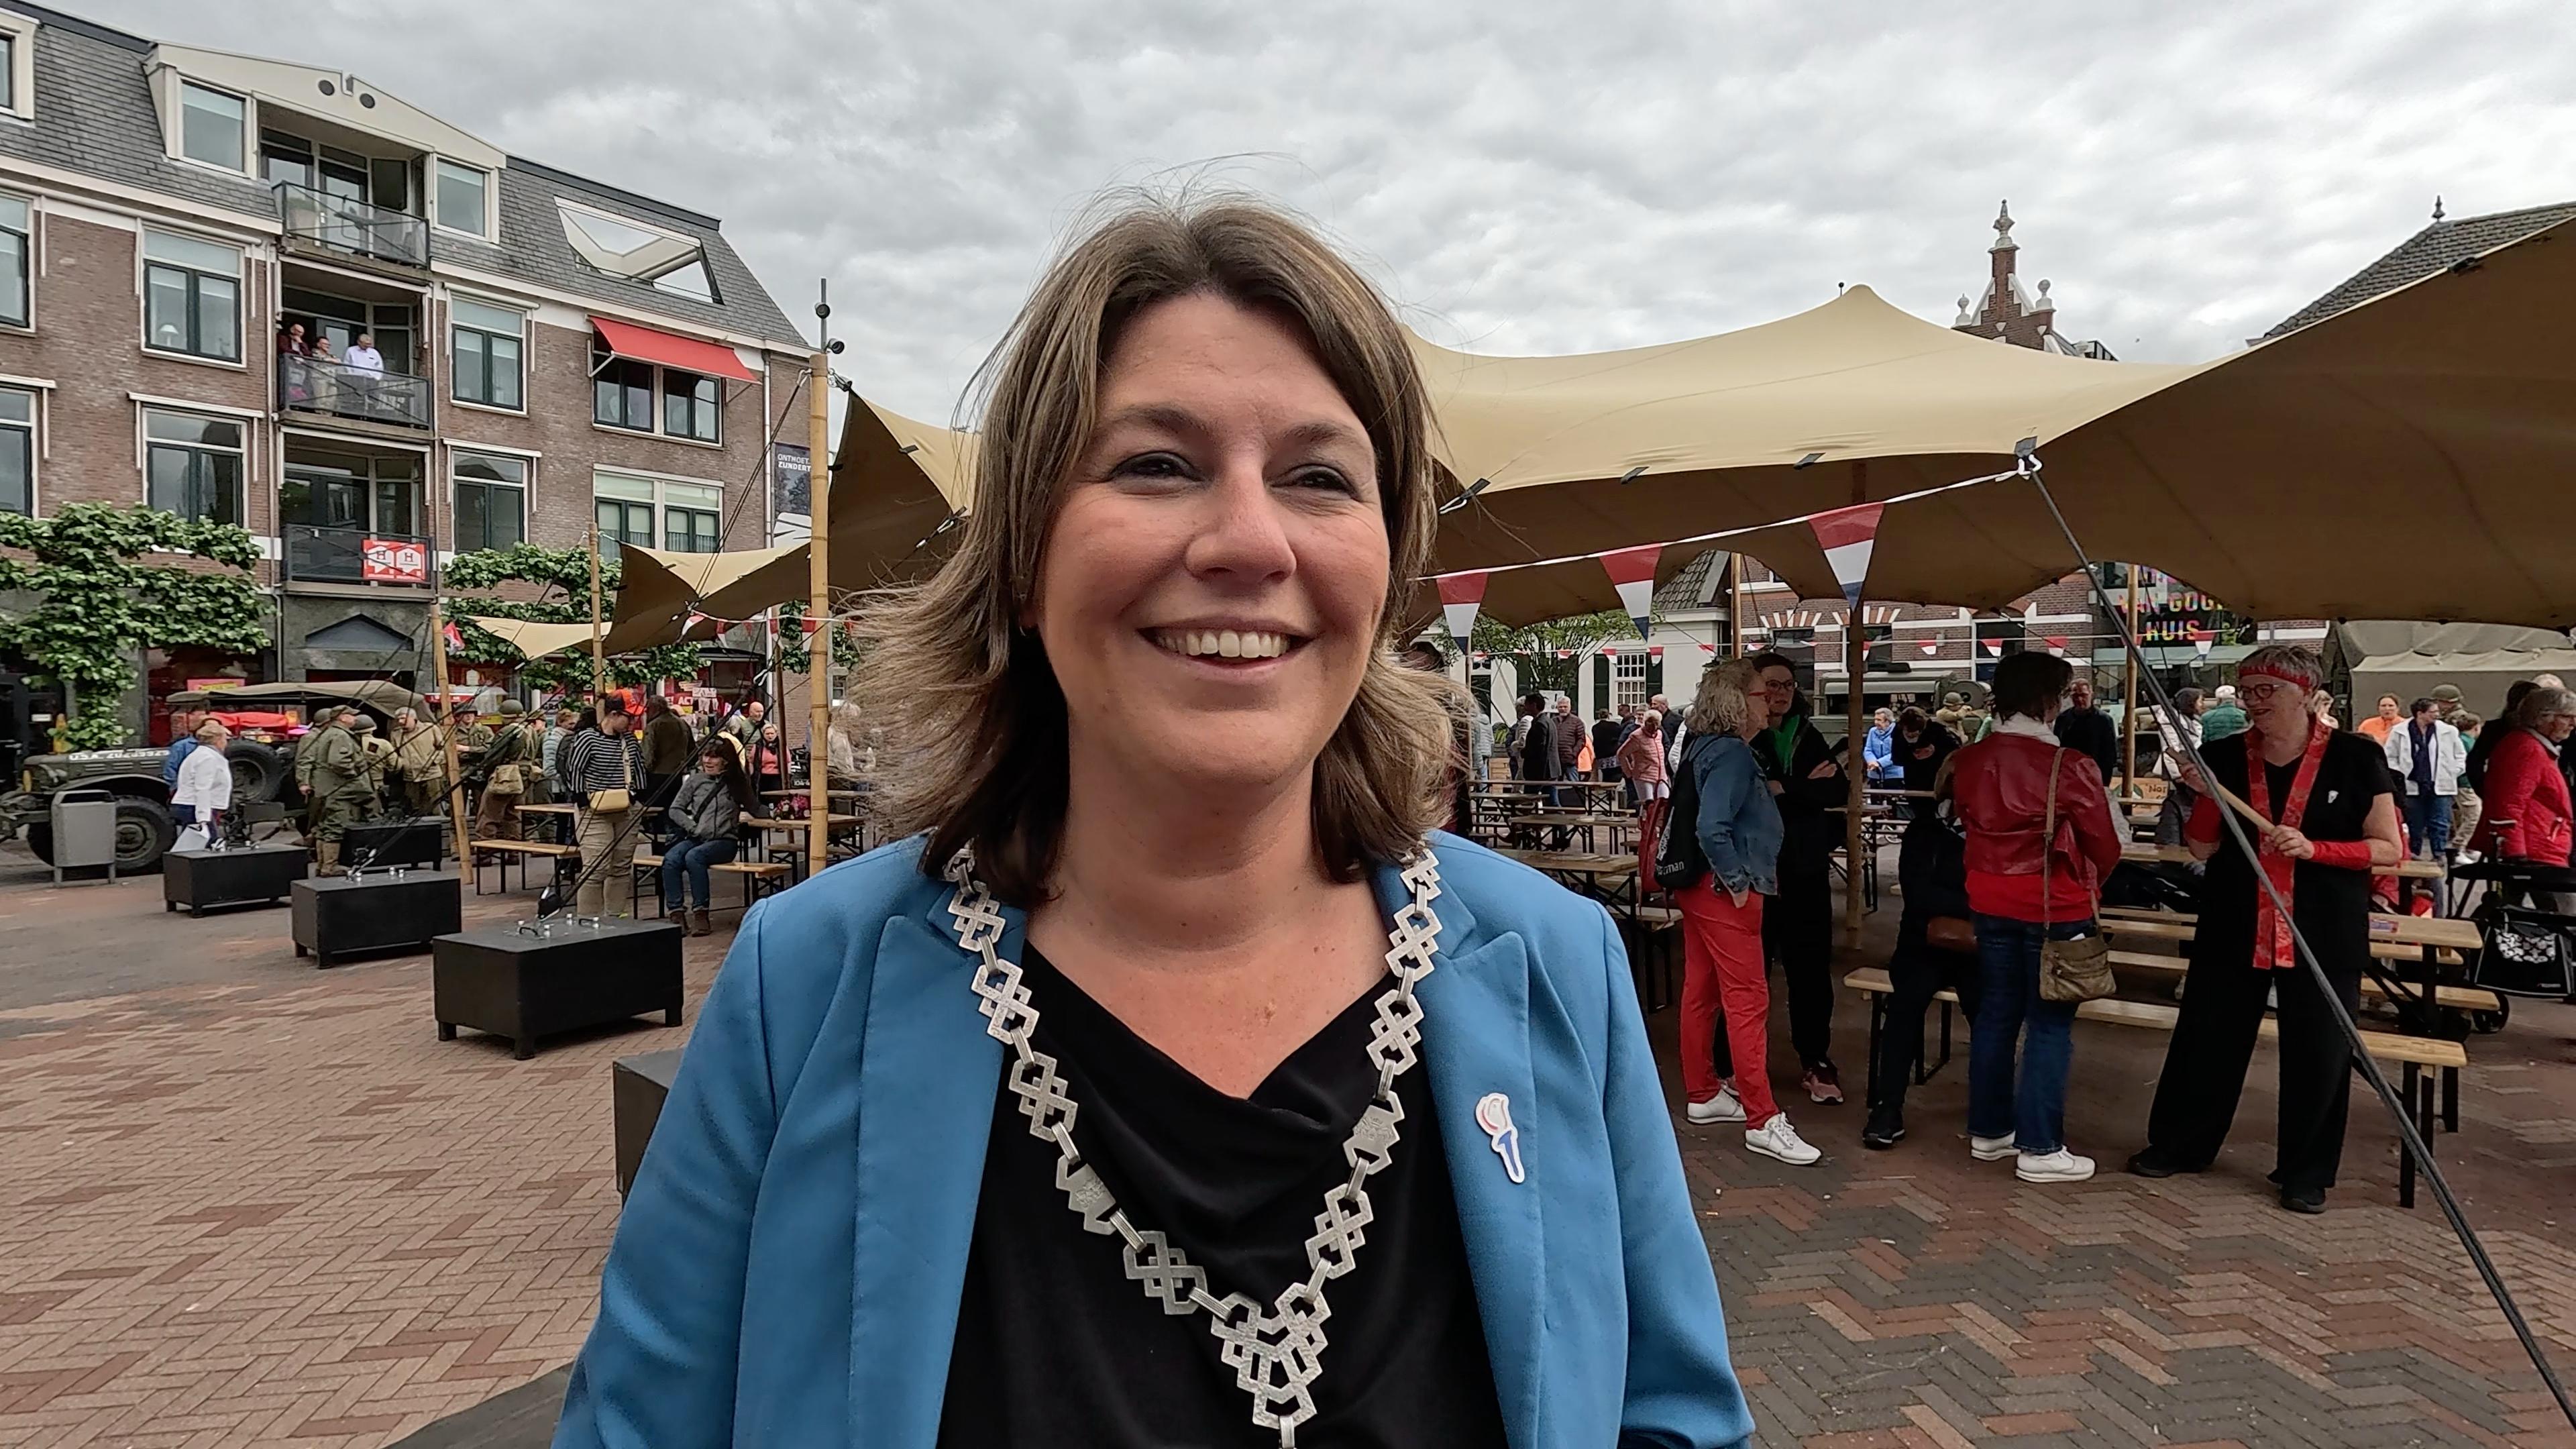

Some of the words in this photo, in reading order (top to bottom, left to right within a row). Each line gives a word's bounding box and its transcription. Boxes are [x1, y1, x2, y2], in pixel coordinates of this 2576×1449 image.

[777, 461, 812, 472] ZUNDERT
[2168, 591, 2222, 612] GOG
[2145, 620, 2200, 641] HUIS
